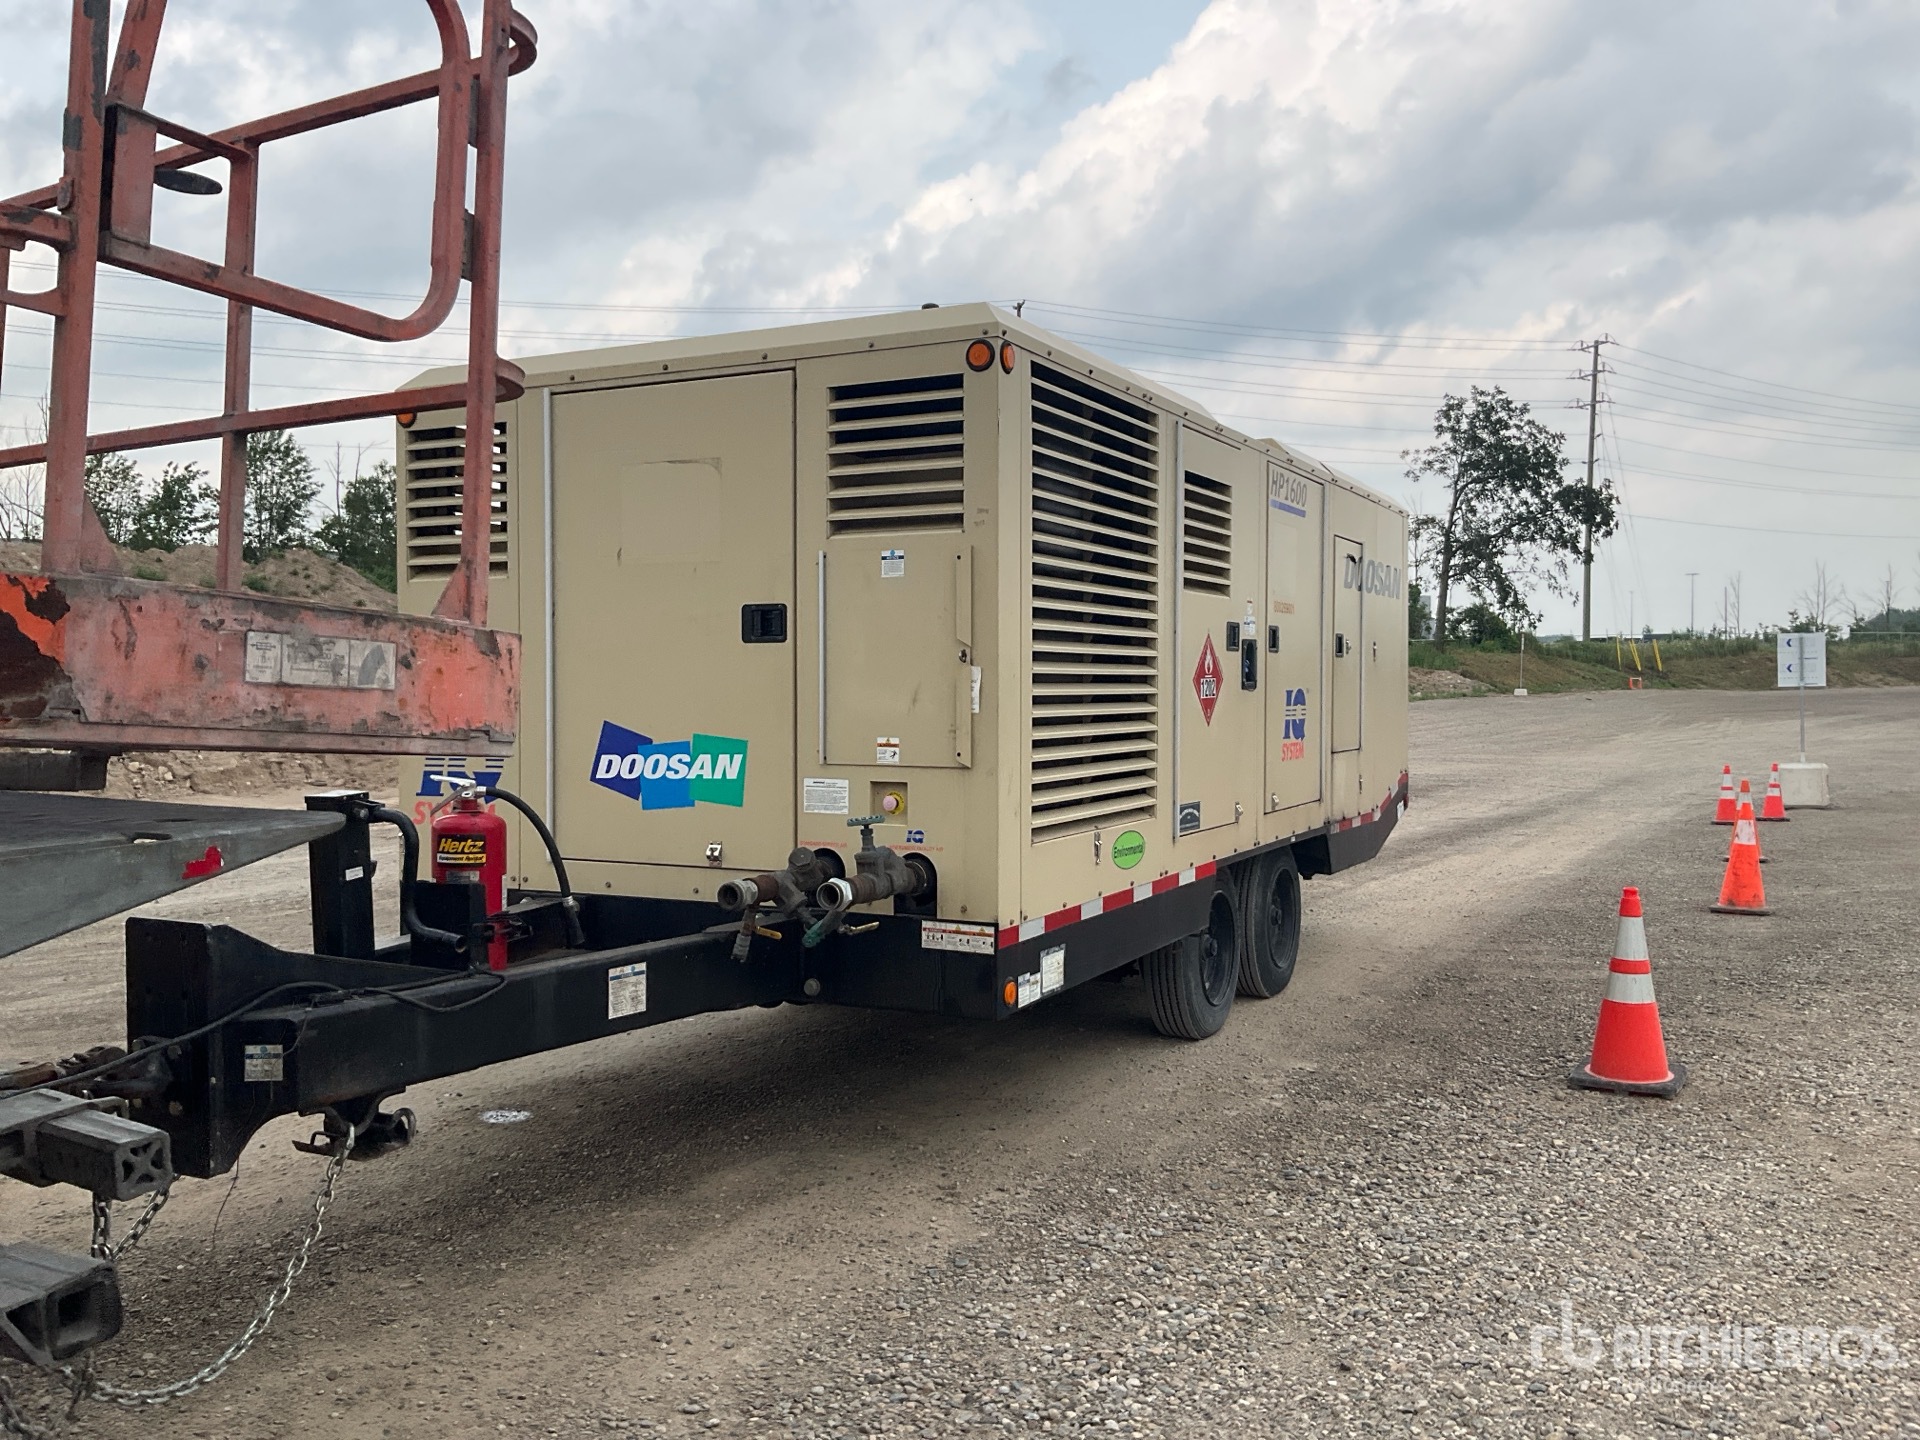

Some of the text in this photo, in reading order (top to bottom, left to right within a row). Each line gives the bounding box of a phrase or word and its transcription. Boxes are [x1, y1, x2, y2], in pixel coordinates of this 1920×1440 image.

[1270, 469, 1307, 507] HP1600
[1343, 555, 1400, 600] DOOSAN
[1201, 679, 1216, 697] 1202
[1282, 741, 1304, 762] SYSTEM
[596, 753, 743, 779] DOOSAN
[439, 838, 484, 853] Hertz
[1114, 843, 1143, 858] Environmental
